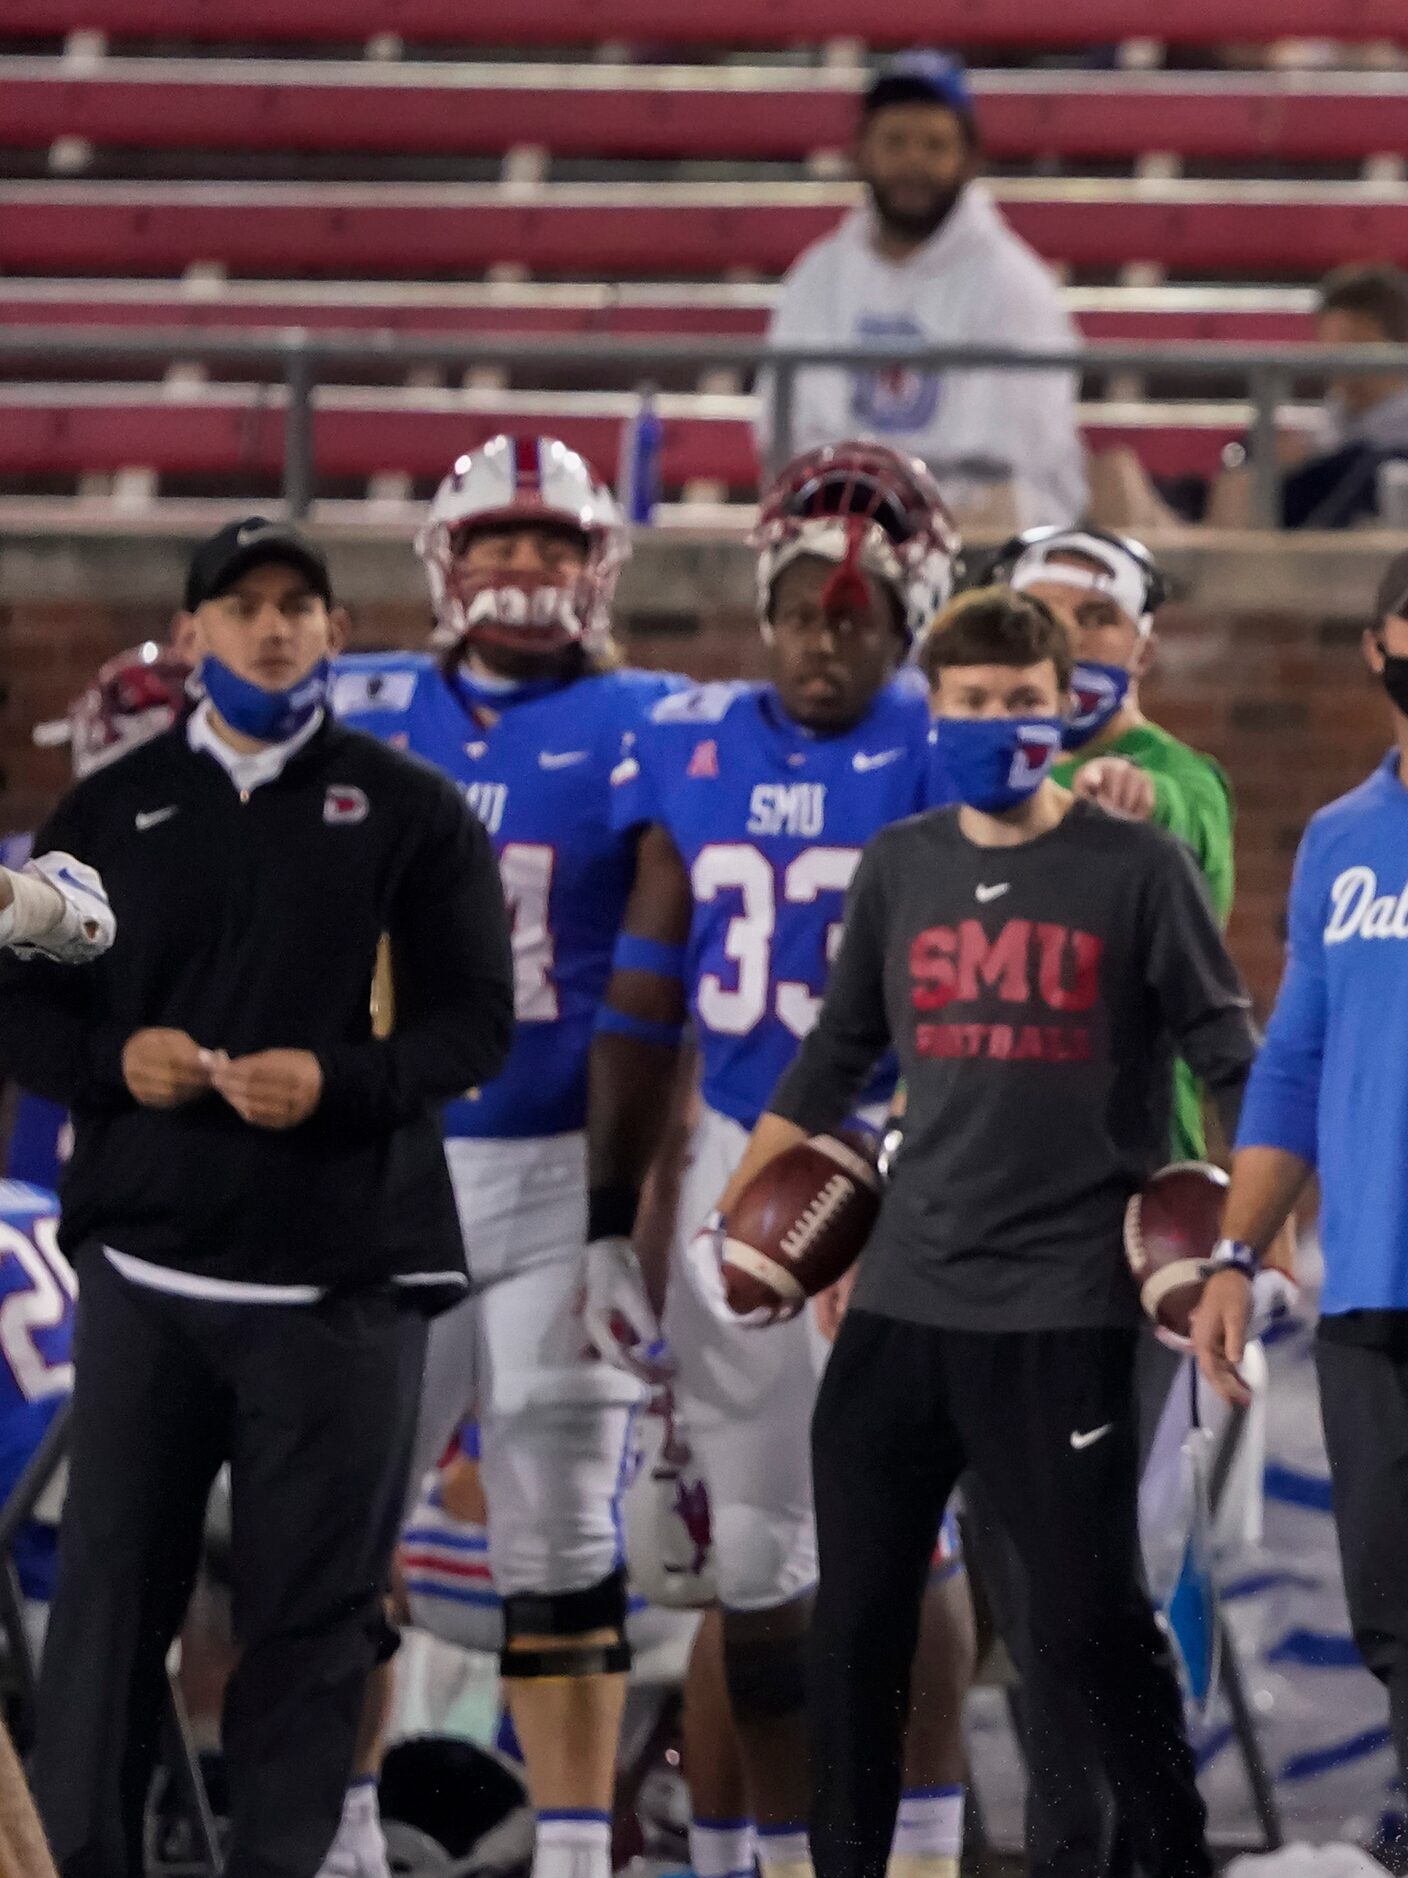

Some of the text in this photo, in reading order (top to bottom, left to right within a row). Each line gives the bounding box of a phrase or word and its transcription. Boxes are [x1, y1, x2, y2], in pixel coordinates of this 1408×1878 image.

[747, 783, 828, 838] SMU
[690, 843, 864, 1040] 33
[908, 918, 1104, 1013] SMU
